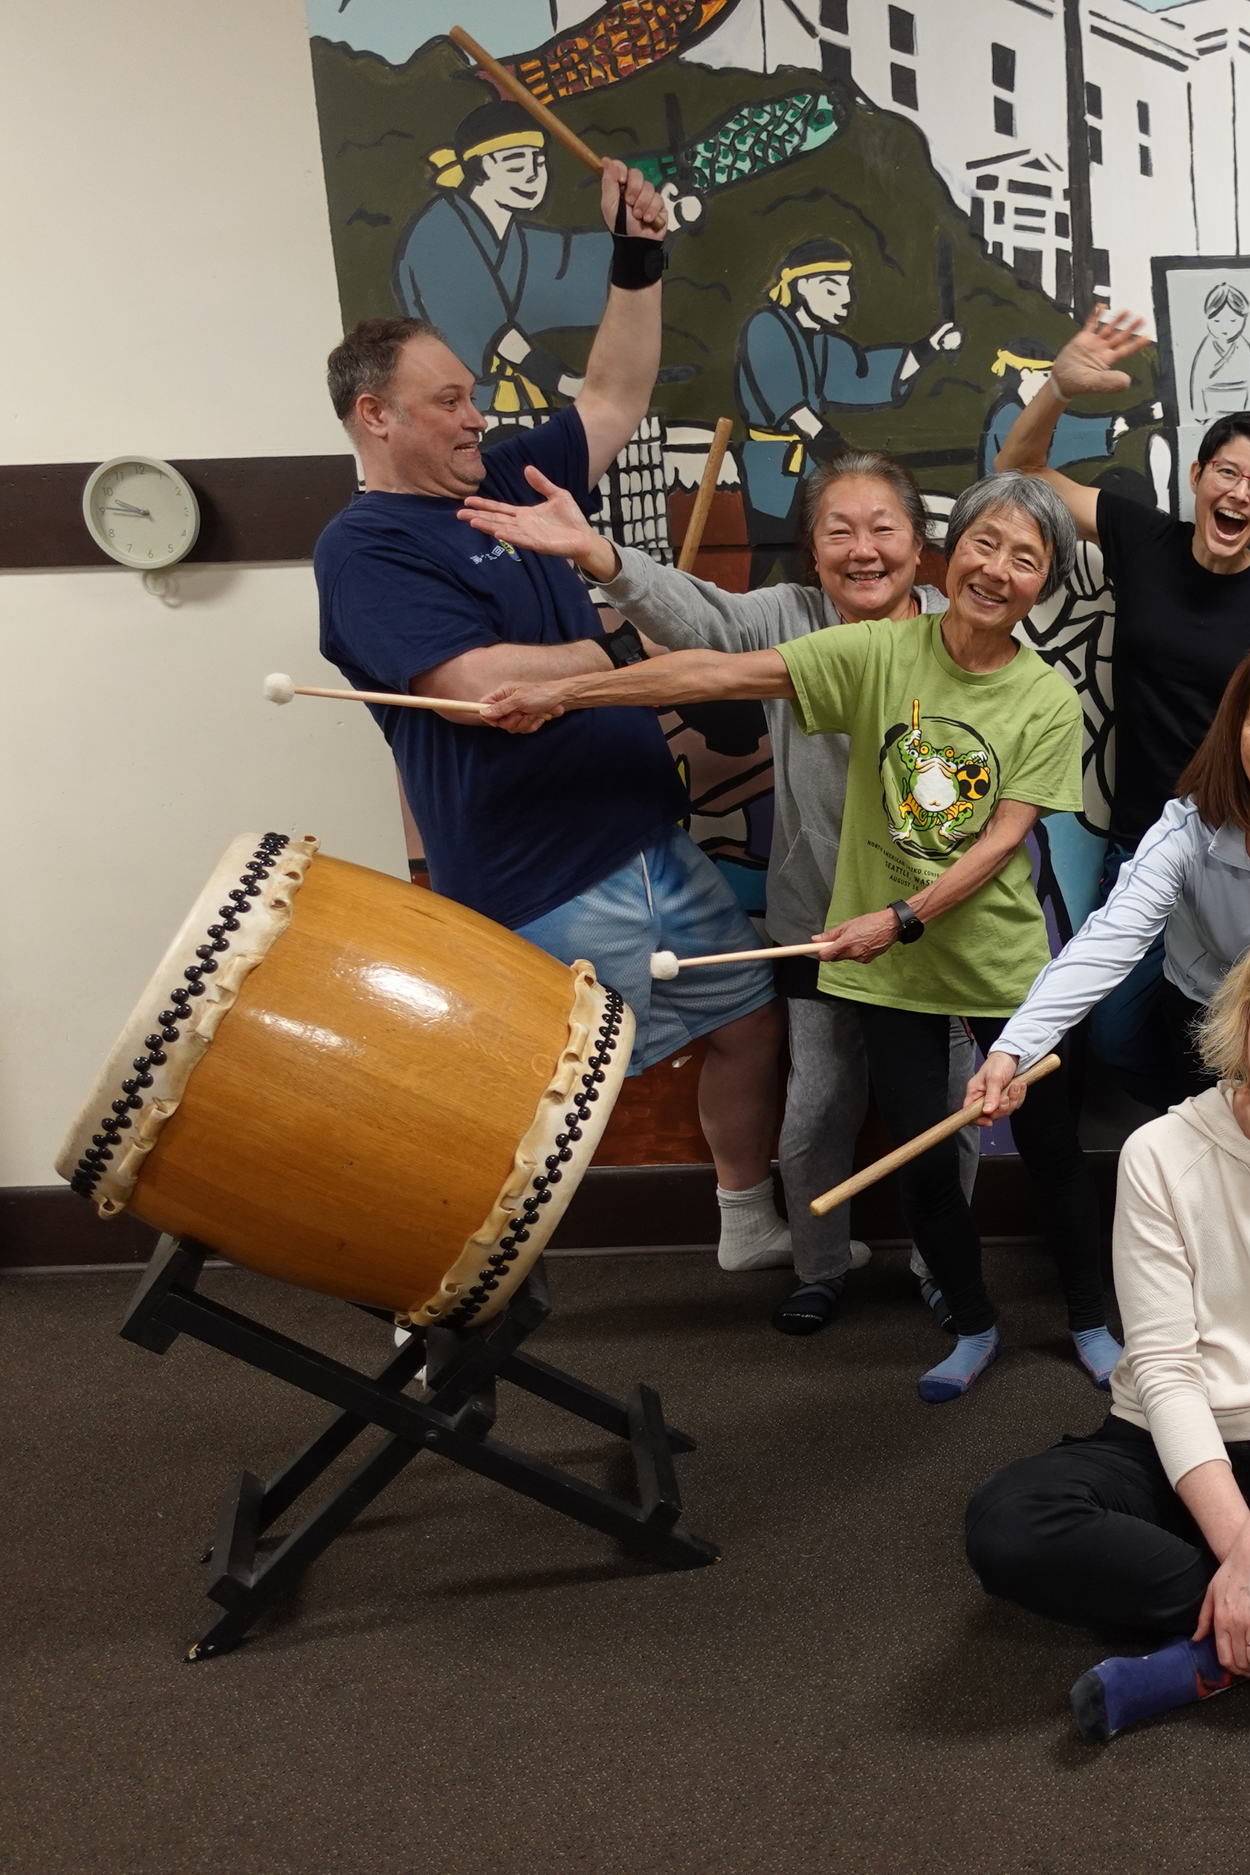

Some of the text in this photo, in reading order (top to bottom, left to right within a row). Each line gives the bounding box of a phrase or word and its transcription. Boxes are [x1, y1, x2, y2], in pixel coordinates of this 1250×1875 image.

[135, 465, 145, 475] 12
[115, 471, 124, 481] 11
[103, 487, 113, 497] 10
[100, 506, 106, 516] 9
[108, 528, 115, 538] 8
[127, 544, 133, 553] 7
[167, 543, 174, 553] 5
[148, 549, 154, 558] 6
[890, 875, 911, 888] AUGUST
